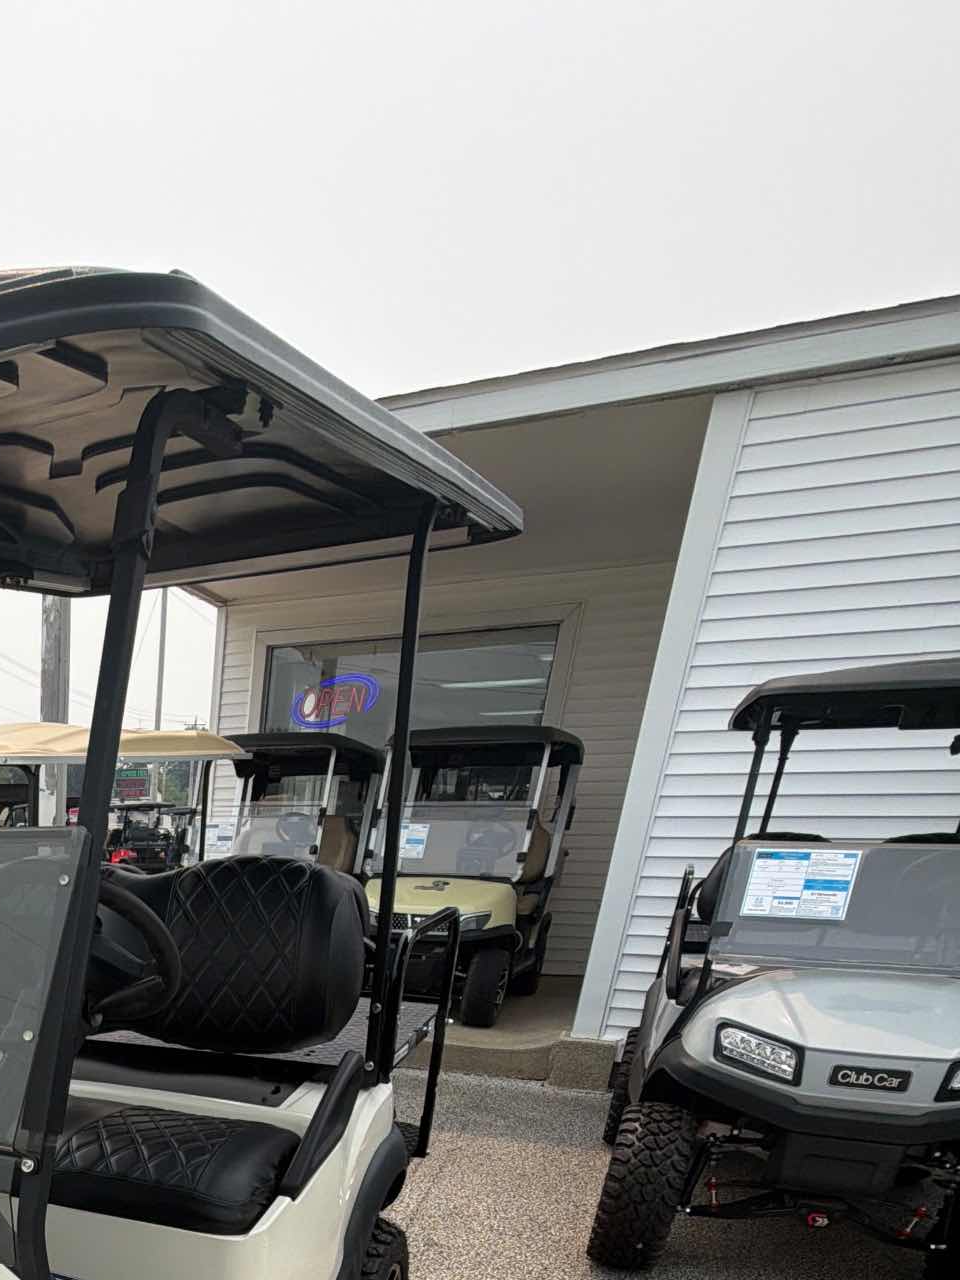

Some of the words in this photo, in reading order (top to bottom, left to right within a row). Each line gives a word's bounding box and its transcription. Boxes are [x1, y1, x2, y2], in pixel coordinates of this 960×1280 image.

[301, 687, 366, 719] OPEN
[838, 1069, 873, 1085] Club
[874, 1073, 904, 1088] Car
